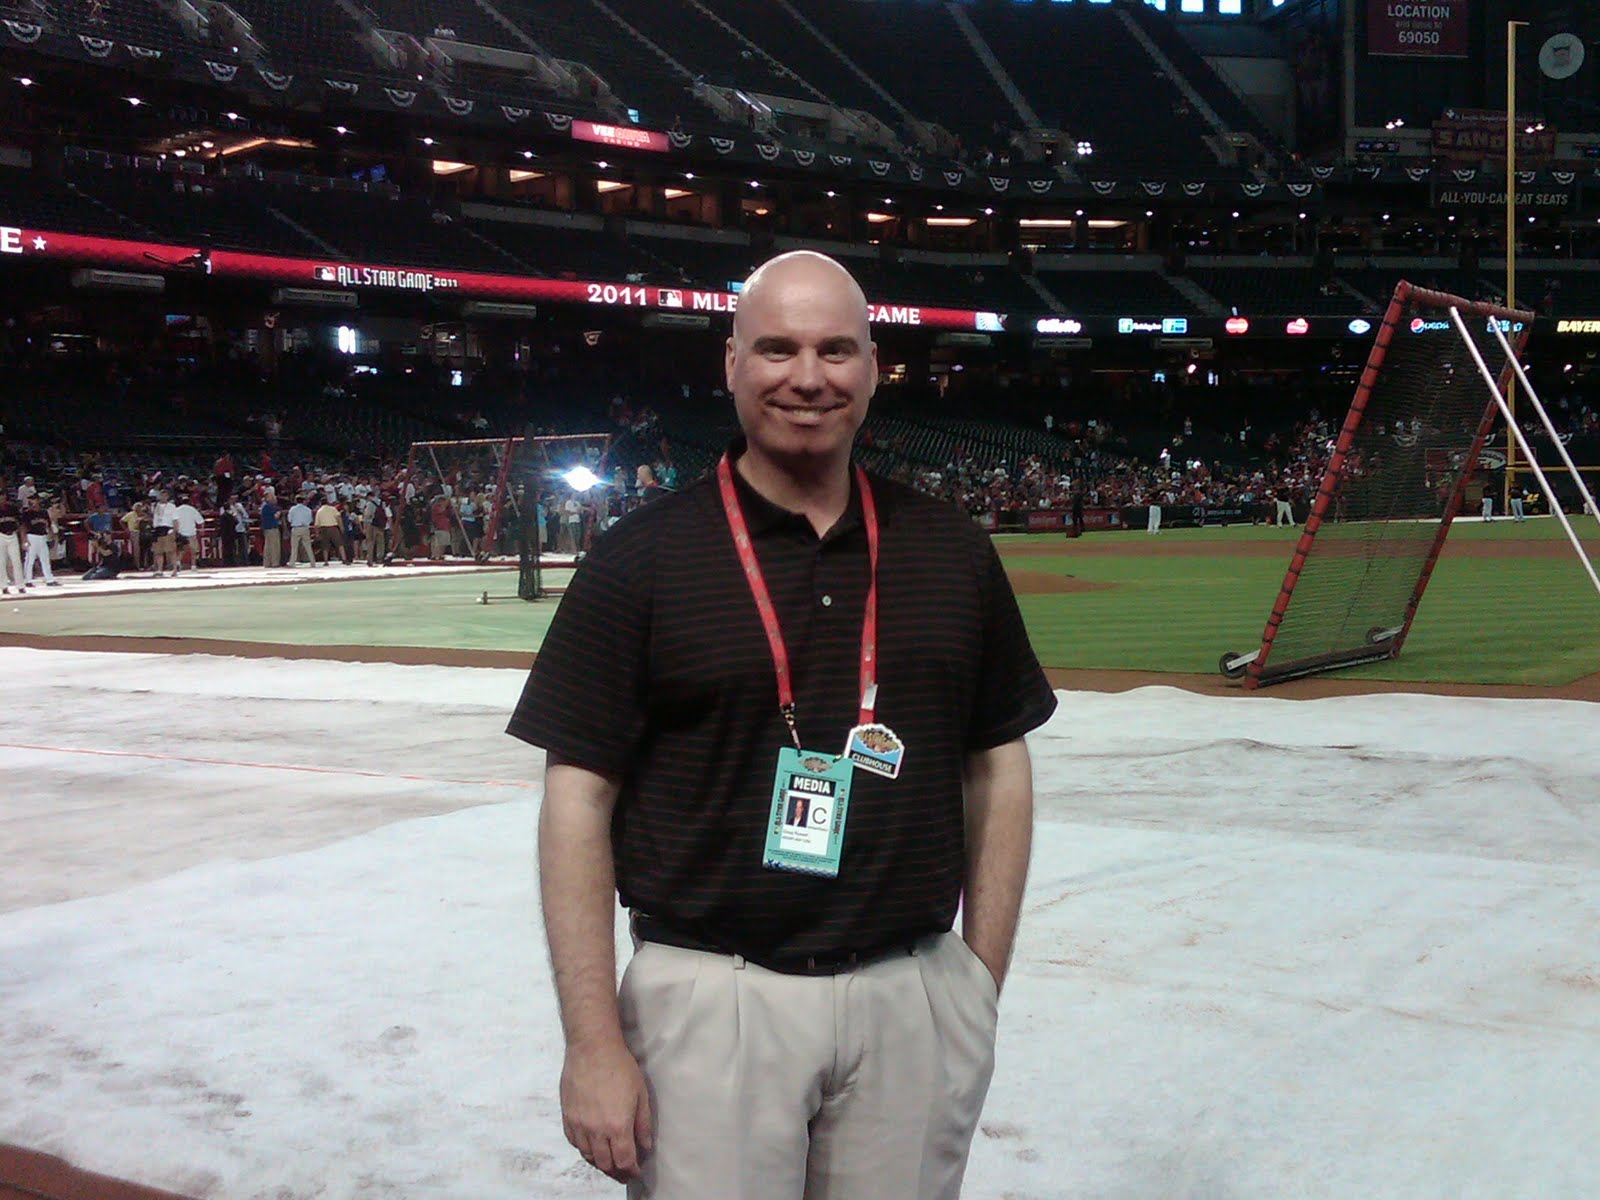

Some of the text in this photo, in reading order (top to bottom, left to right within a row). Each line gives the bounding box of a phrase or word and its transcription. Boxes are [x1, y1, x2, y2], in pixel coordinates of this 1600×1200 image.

[1387, 4, 1450, 18] LOCATION
[1398, 31, 1440, 44] 69050
[1535, 193, 1568, 205] SEATS
[337, 265, 458, 292] ALL STAR GAME 2011
[587, 284, 647, 306] 2011
[851, 752, 893, 773] CLUBHOUSE
[793, 776, 831, 794] MEDIA
[812, 807, 827, 825] C
